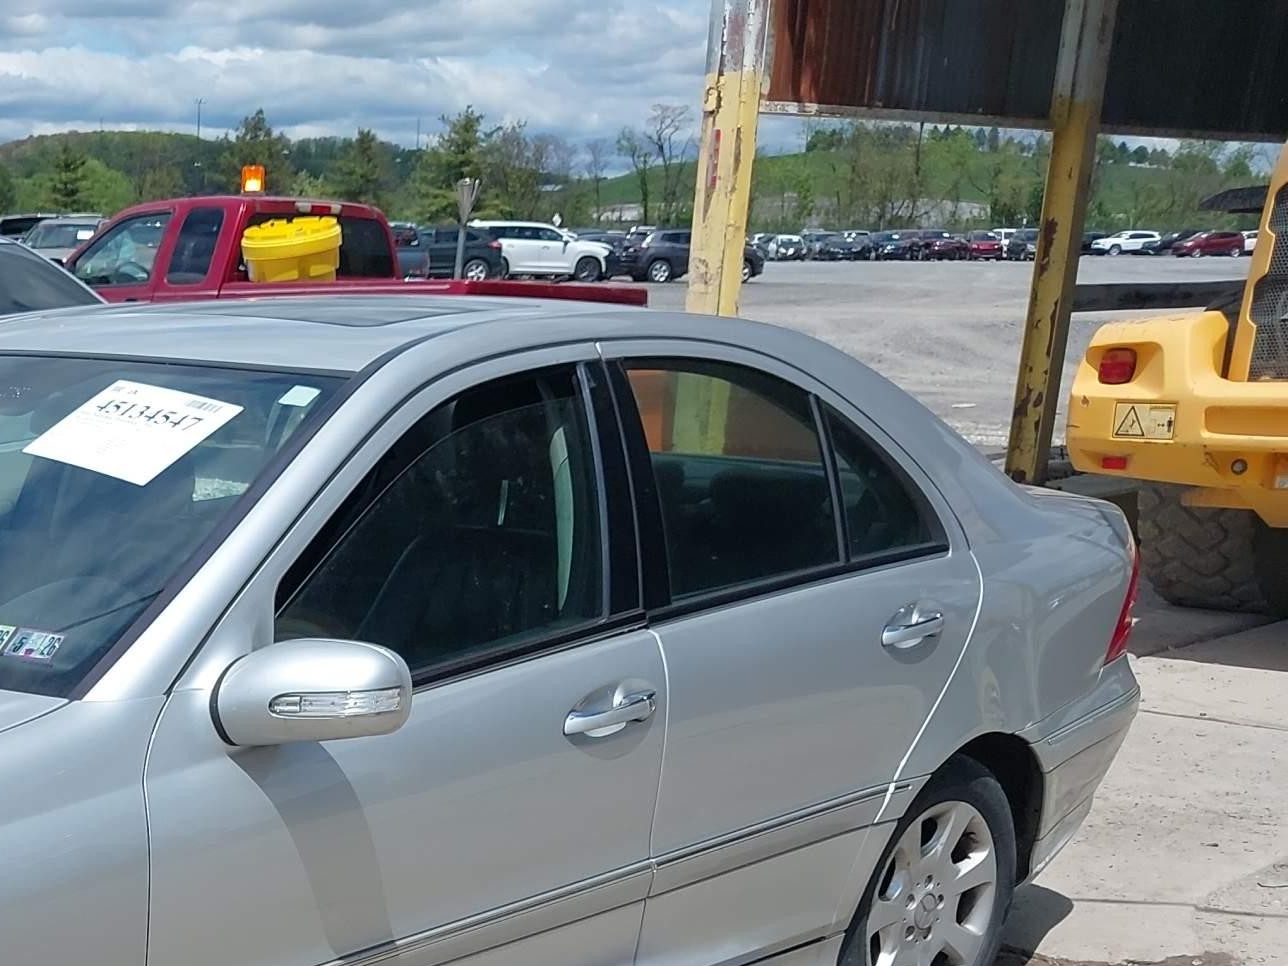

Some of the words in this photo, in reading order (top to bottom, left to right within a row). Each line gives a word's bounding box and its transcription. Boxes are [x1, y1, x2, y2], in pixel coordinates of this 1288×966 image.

[97, 399, 204, 431] 45134547
[12, 636, 28, 653] 5
[40, 636, 61, 656] 26
